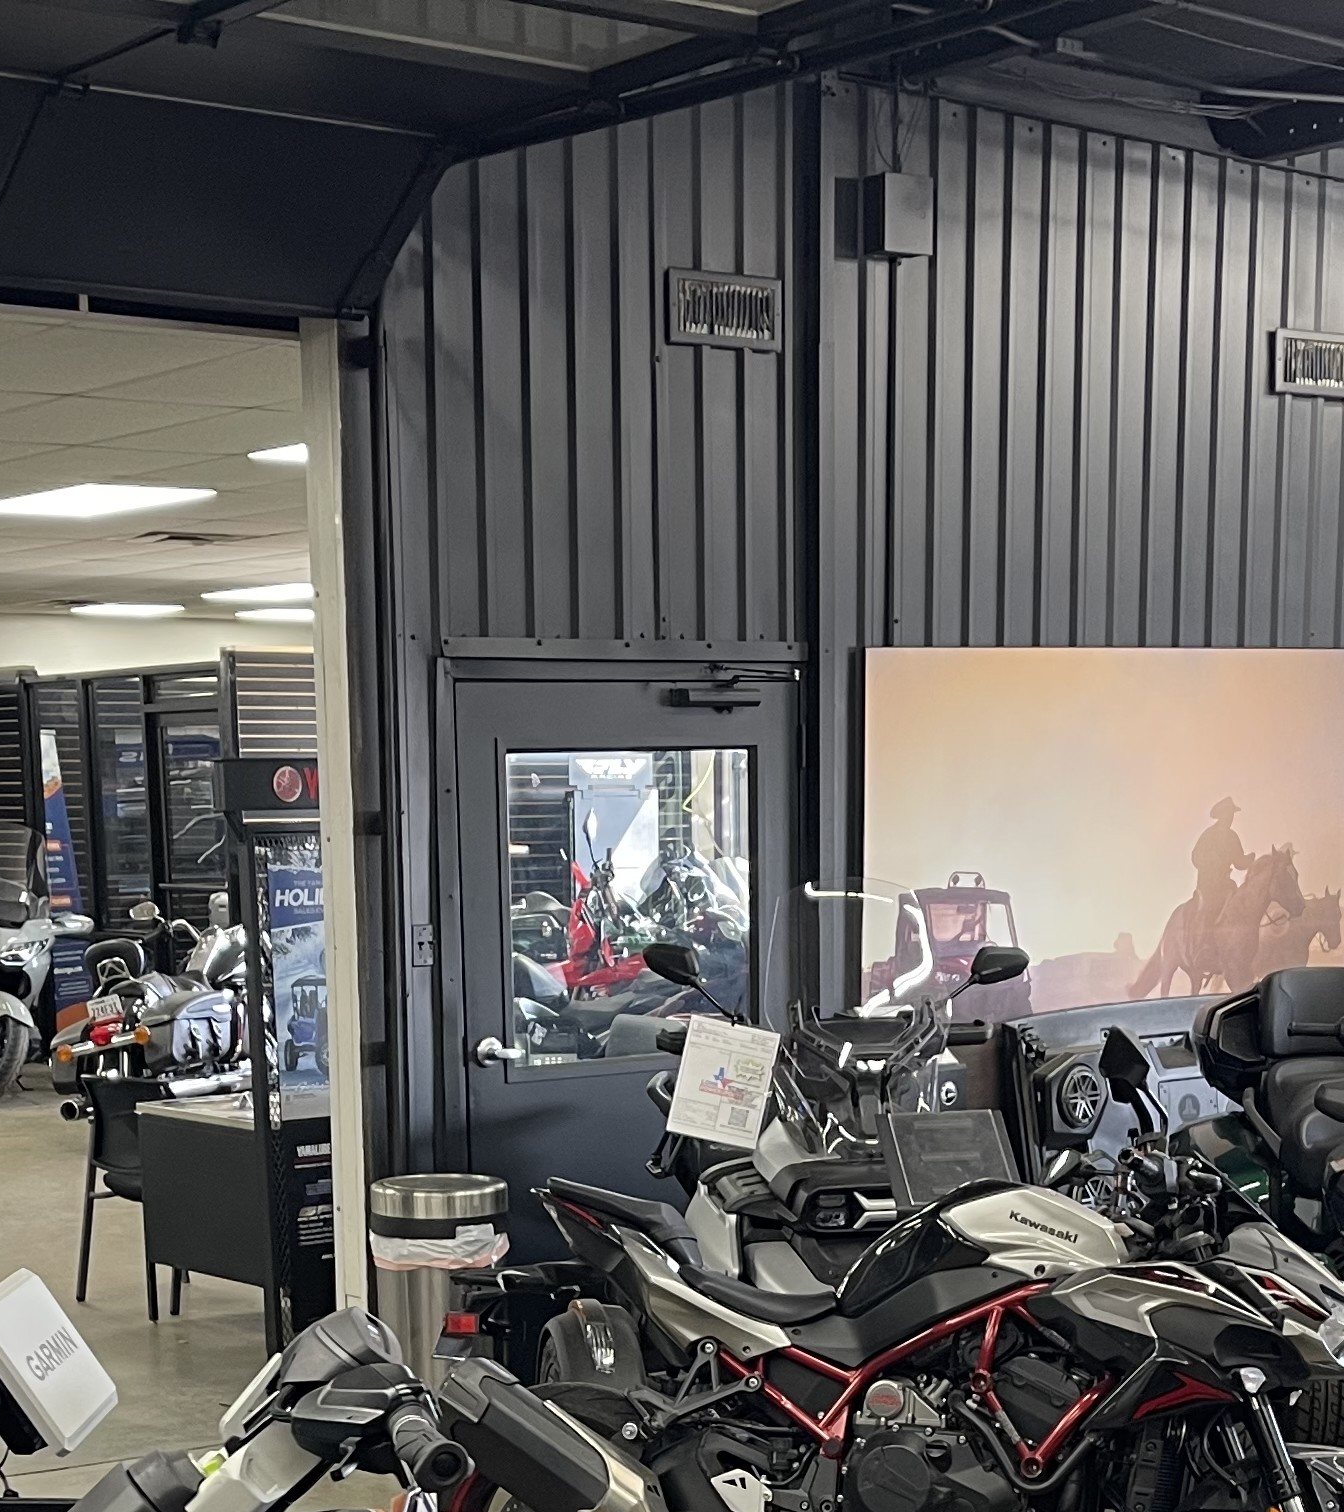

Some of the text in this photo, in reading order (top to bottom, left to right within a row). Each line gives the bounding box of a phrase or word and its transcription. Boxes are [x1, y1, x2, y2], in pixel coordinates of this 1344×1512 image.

[275, 889, 324, 908] HOLI
[1009, 1210, 1078, 1244] Kawasaki
[25, 1325, 79, 1382] GARMIN
